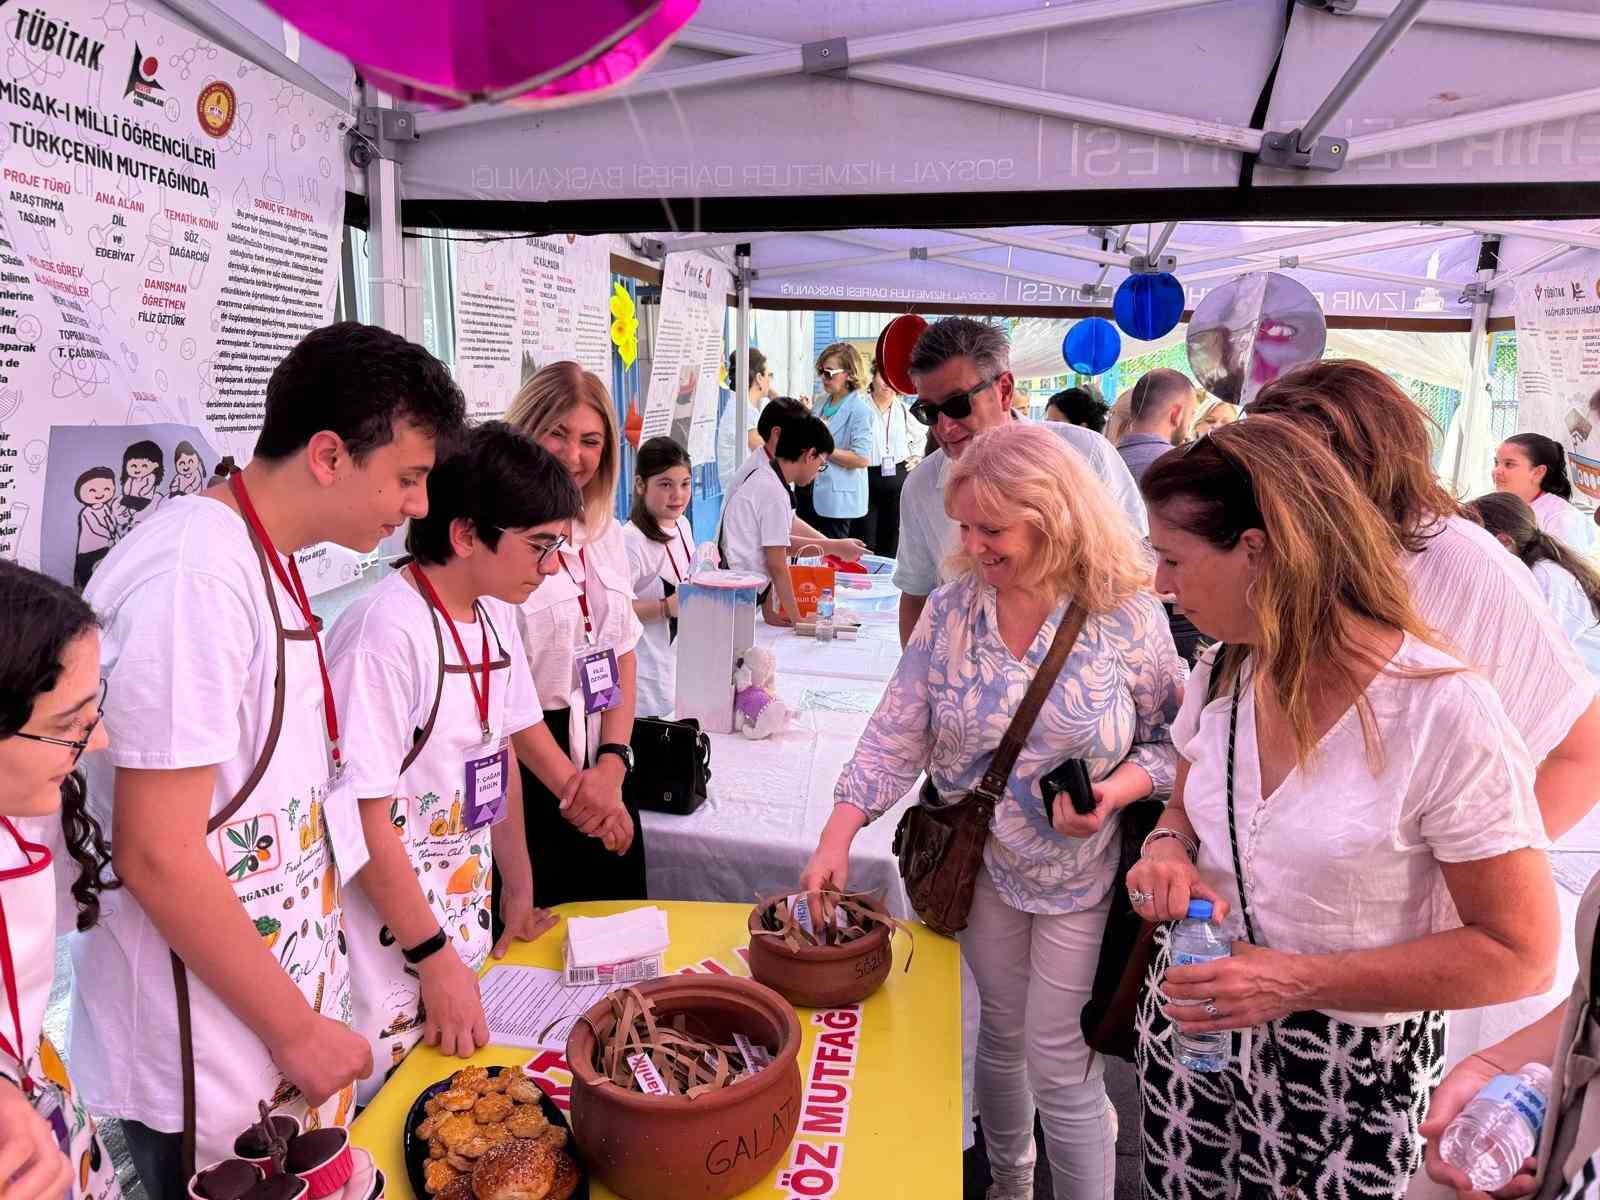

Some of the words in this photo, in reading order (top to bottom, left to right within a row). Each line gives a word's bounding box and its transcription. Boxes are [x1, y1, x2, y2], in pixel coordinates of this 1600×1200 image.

[15, 8, 105, 71] TÜBİTAK
[0, 77, 70, 122] MİSAK-I
[75, 105, 119, 137] MİLLÎ
[121, 117, 216, 170] ÖĞRENCİLERİ
[9, 121, 113, 172] TÜRKÇENİN
[117, 154, 209, 199] MUTFAĞINDA
[4, 168, 40, 188] PROJE
[42, 177, 71, 195] TÜRÜ
[10, 190, 64, 212] ARAŞTIRMA
[95, 192, 116, 206] ANA
[117, 197, 145, 213] ALANI
[254, 198, 276, 213] SONUÇ
[277, 205, 286, 215] VE
[18, 210, 57, 228] TASARIM
[112, 213, 127, 227] DİL
[164, 208, 198, 226] TEMATİK
[199, 217, 219, 231] KONU
[184, 230, 199, 243] SÖZ
[95, 247, 135, 263] EDEBİYAT
[169, 245, 210, 263] DAĞARCIĞI
[144, 278, 187, 294] DANIŞMAN
[142, 295, 186, 310] ÖĞRETMEN
[138, 311, 156, 323] FİLİZ
[157, 312, 186, 326] ÖZTÜRK
[782, 1143, 839, 1200] ÖZ
